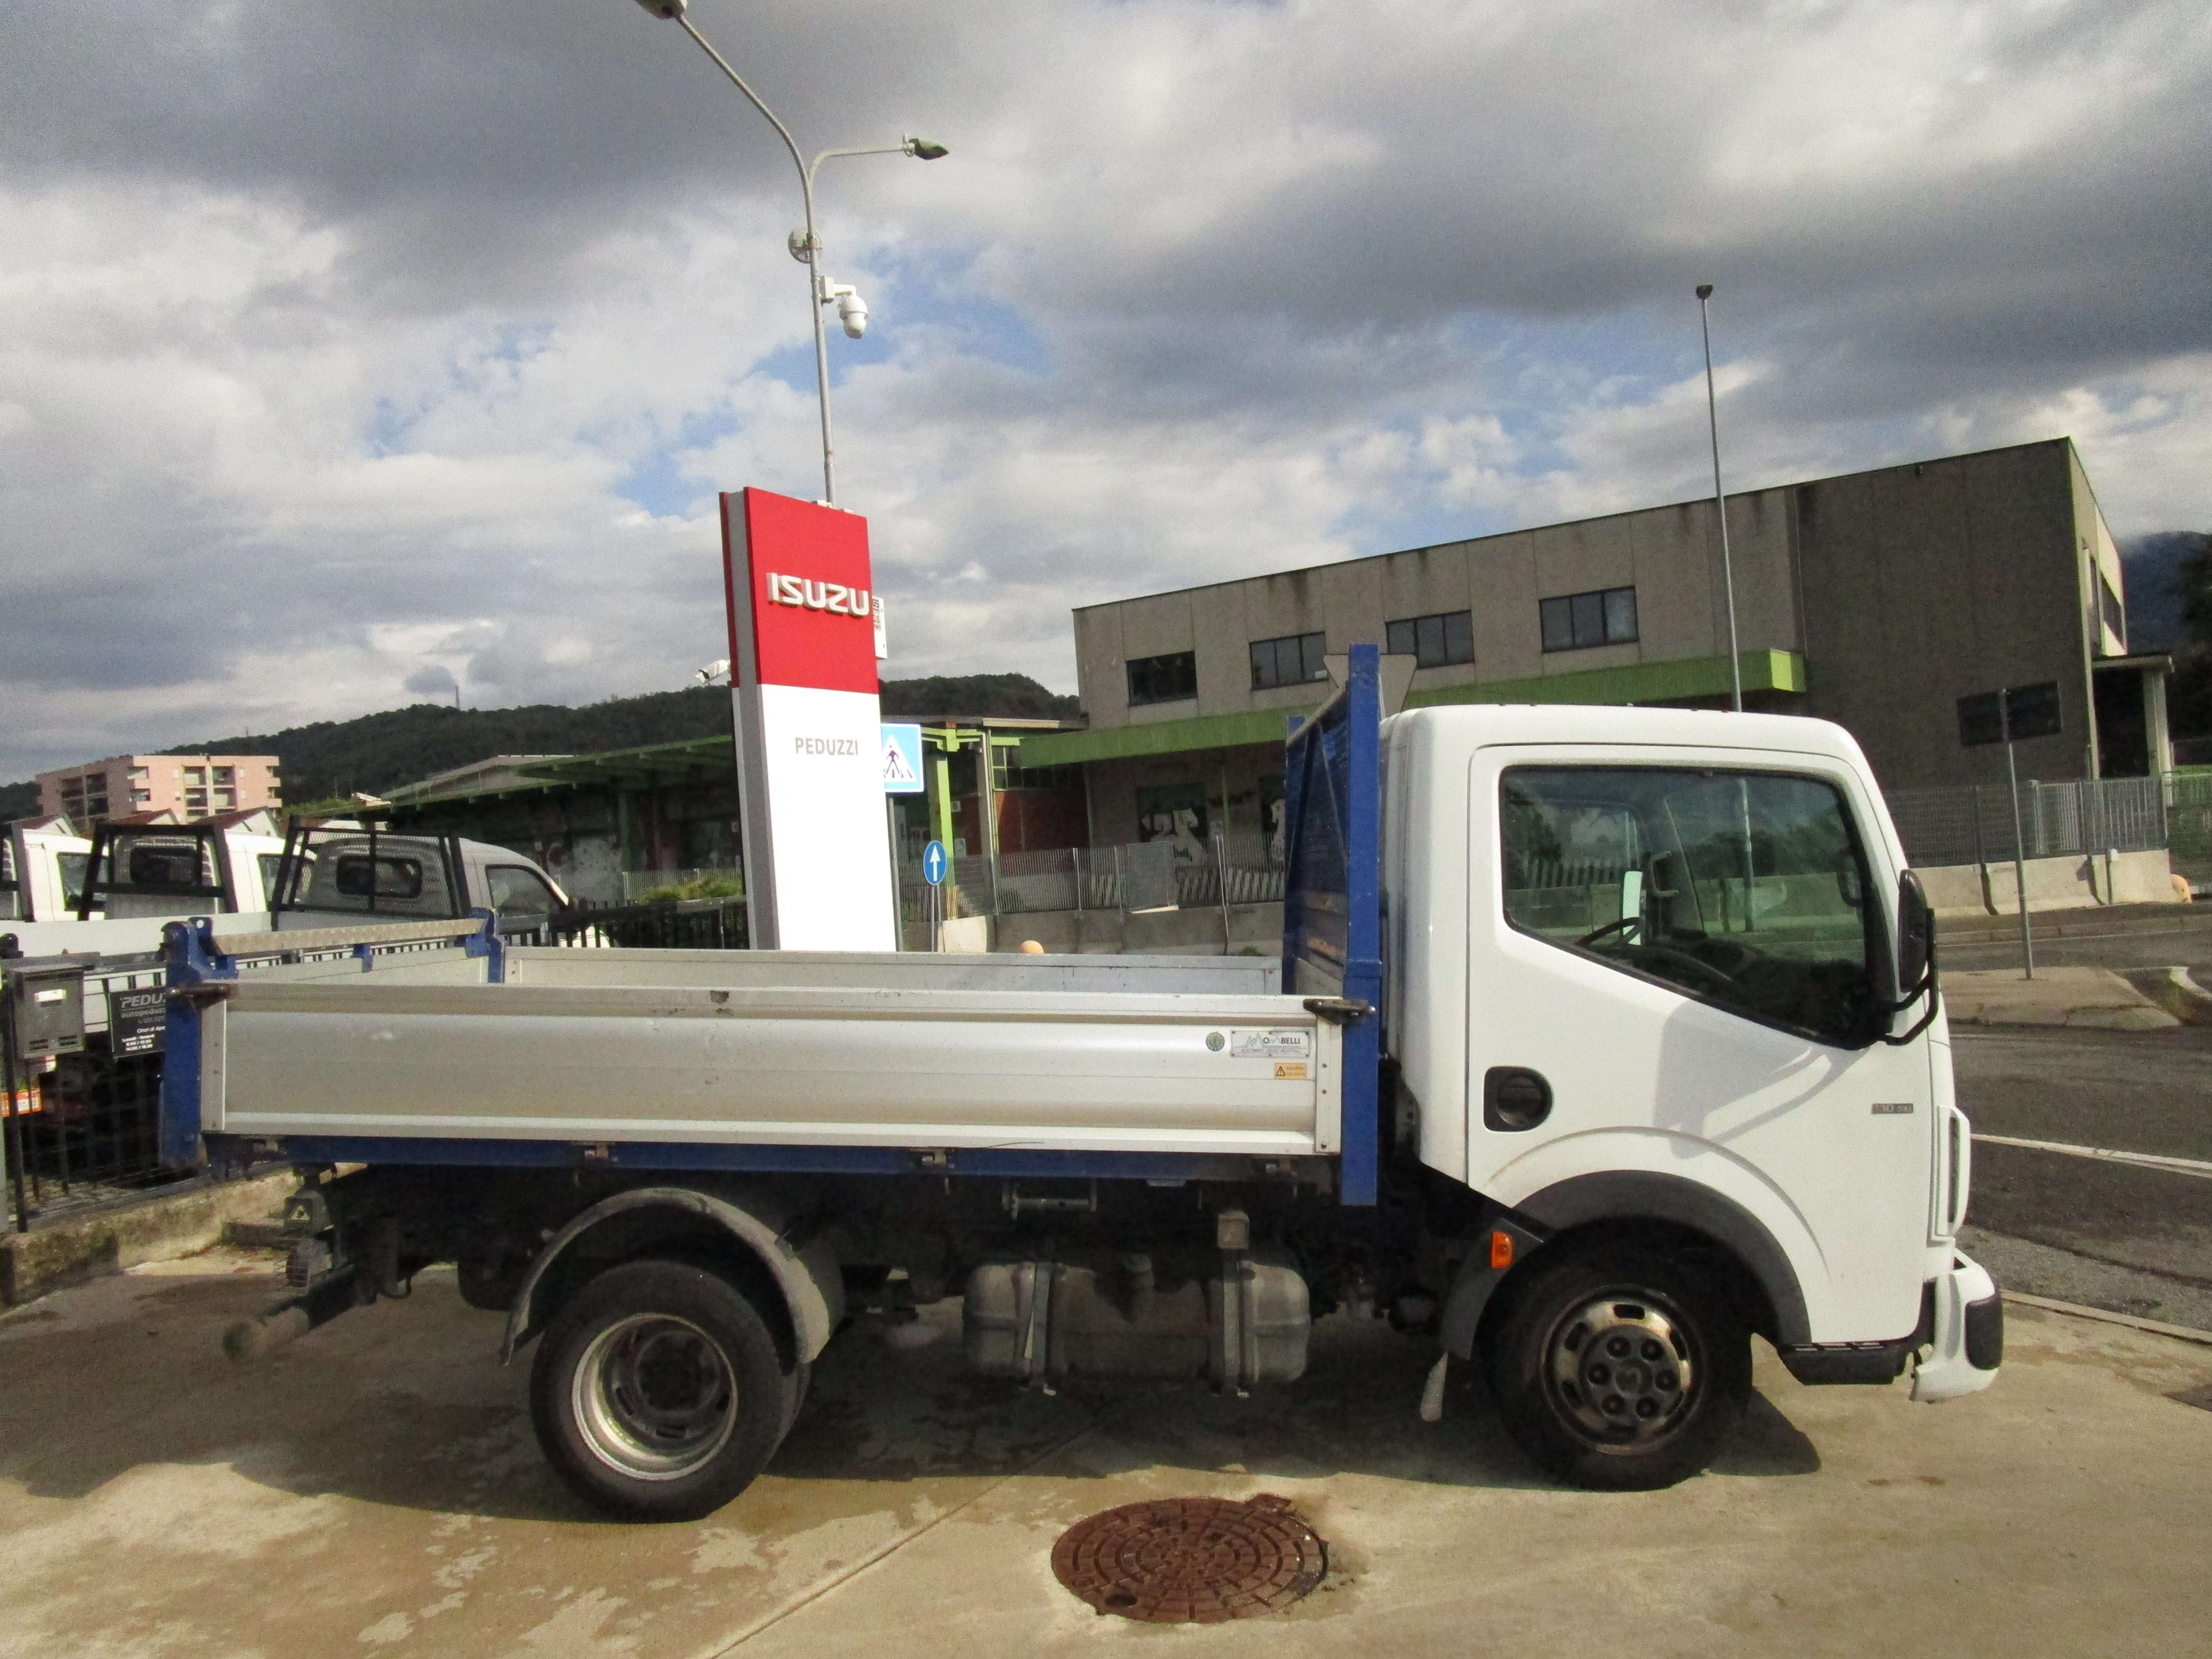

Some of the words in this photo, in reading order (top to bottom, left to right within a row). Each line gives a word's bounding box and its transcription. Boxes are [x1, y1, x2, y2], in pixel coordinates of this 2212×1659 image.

[766, 572, 869, 616] ISUZU
[795, 737, 859, 756] PEDUZZI
[120, 992, 166, 1008] PEDU
